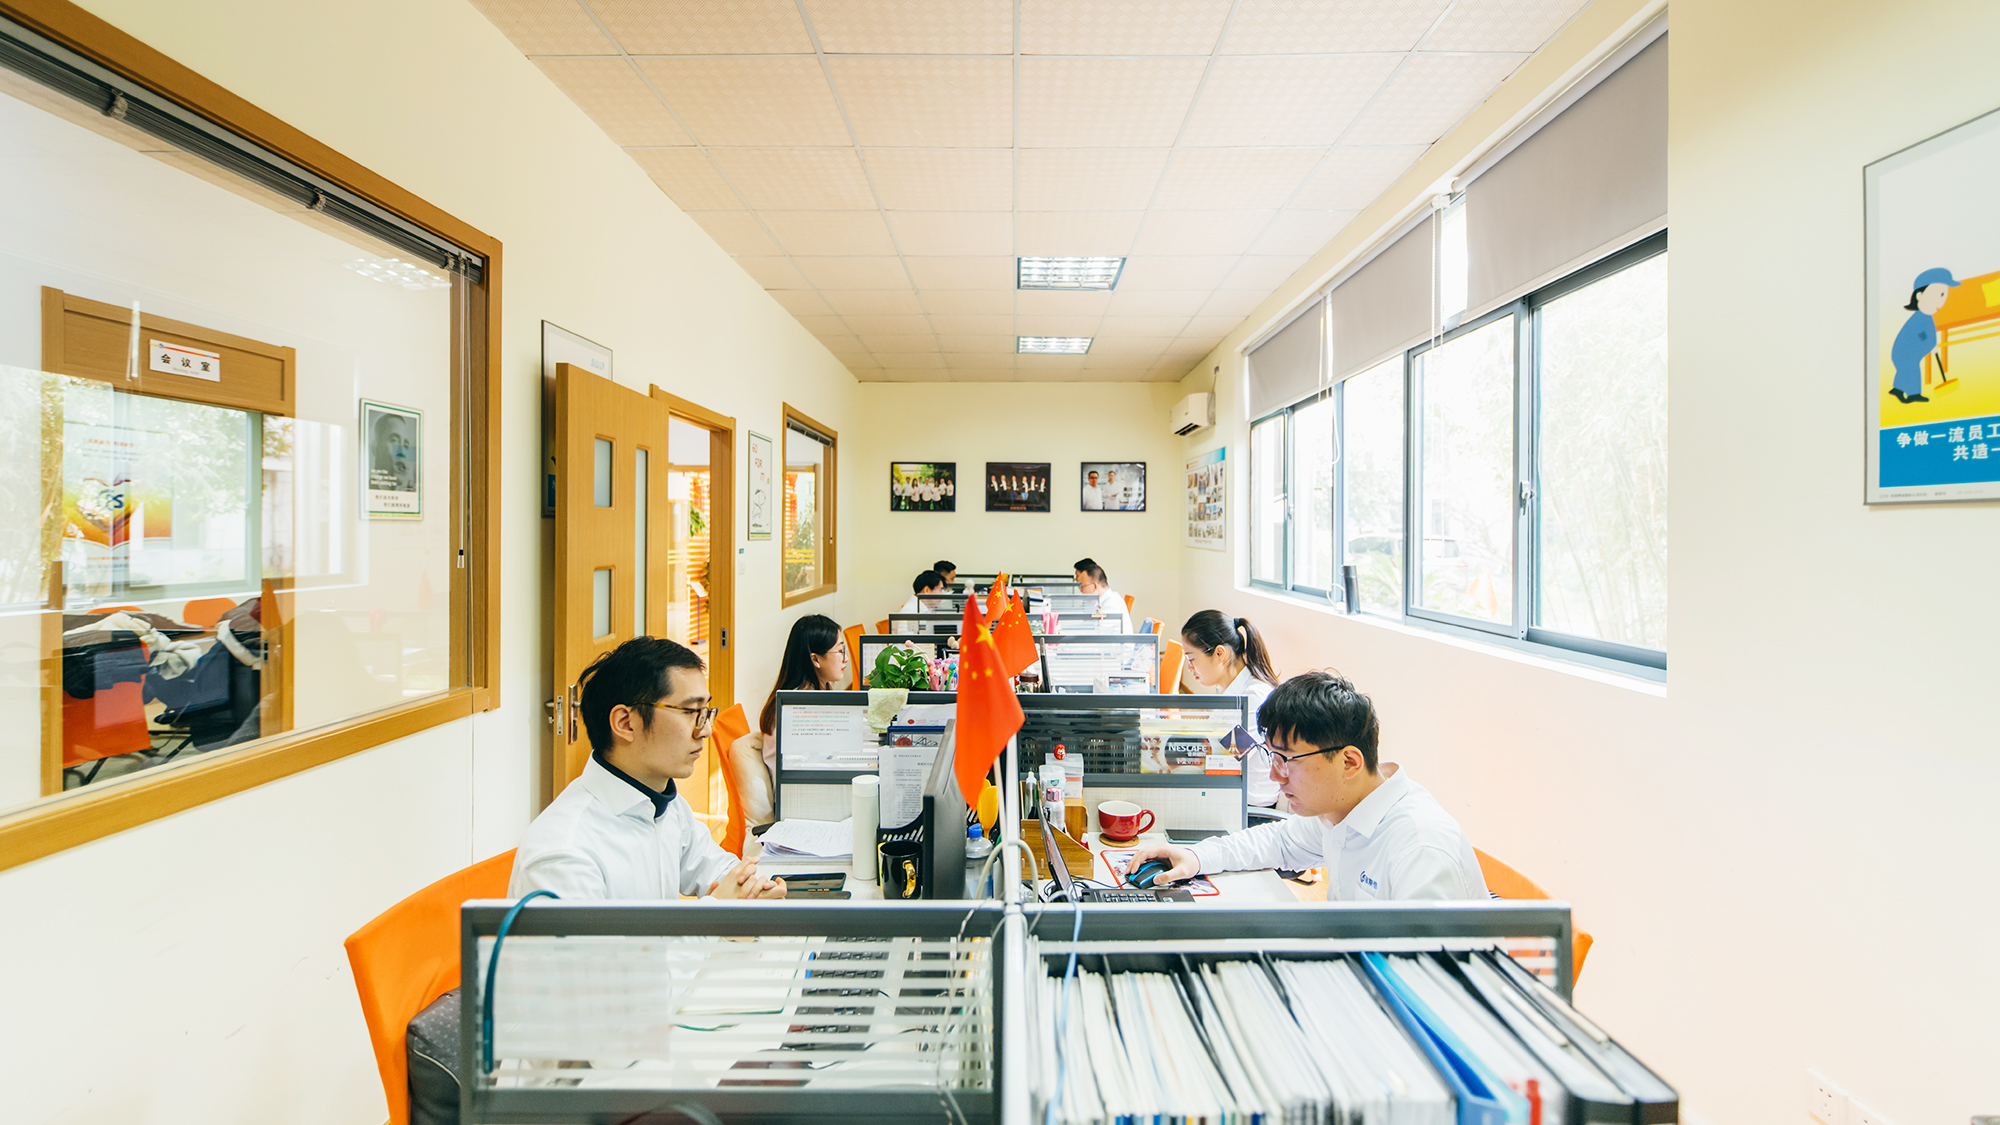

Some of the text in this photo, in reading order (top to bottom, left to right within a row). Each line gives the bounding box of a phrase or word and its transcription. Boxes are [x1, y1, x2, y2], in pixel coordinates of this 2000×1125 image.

[161, 353, 211, 372] 会议室
[1896, 423, 2000, 448] 争做一流员工
